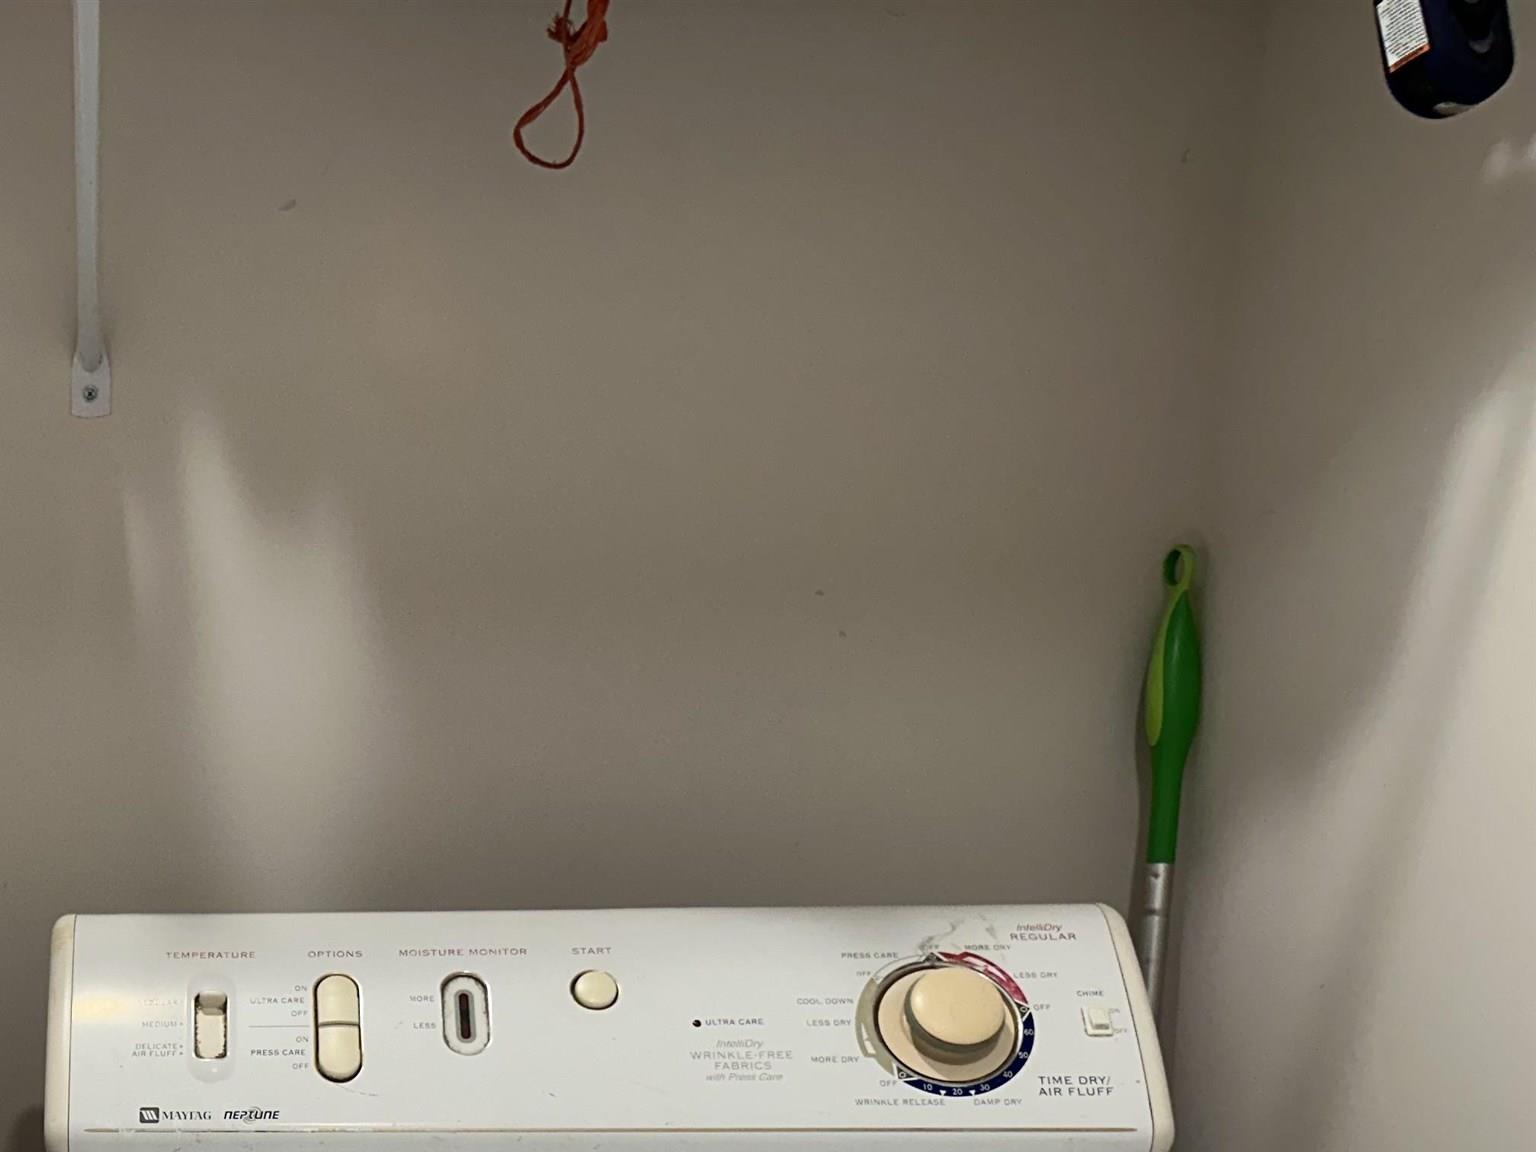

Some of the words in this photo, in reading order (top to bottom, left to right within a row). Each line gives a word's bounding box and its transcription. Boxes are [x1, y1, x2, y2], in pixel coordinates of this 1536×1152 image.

[1010, 933, 1077, 941] REGULAR
[166, 951, 256, 959] TEMPERATURE
[307, 950, 363, 958] OPTIONS
[398, 949, 464, 957] MOISTURE
[468, 948, 528, 956] MONITOR
[571, 947, 612, 955] START
[1023, 1028, 1034, 1036] 60
[689, 1051, 793, 1060] WRINKLE-FREE
[714, 1061, 772, 1070] FABRICS
[706, 1073, 725, 1081] with
[728, 1073, 756, 1081] Press
[759, 1073, 783, 1081] Care
[1038, 1076, 1074, 1085] TIME
[1078, 1075, 1111, 1085] DRY/
[923, 1083, 933, 1091] 10
[1039, 1087, 1063, 1096] AIR
[1068, 1087, 1115, 1096] FLUFF
[162, 1111, 212, 1120] MAYTAG
